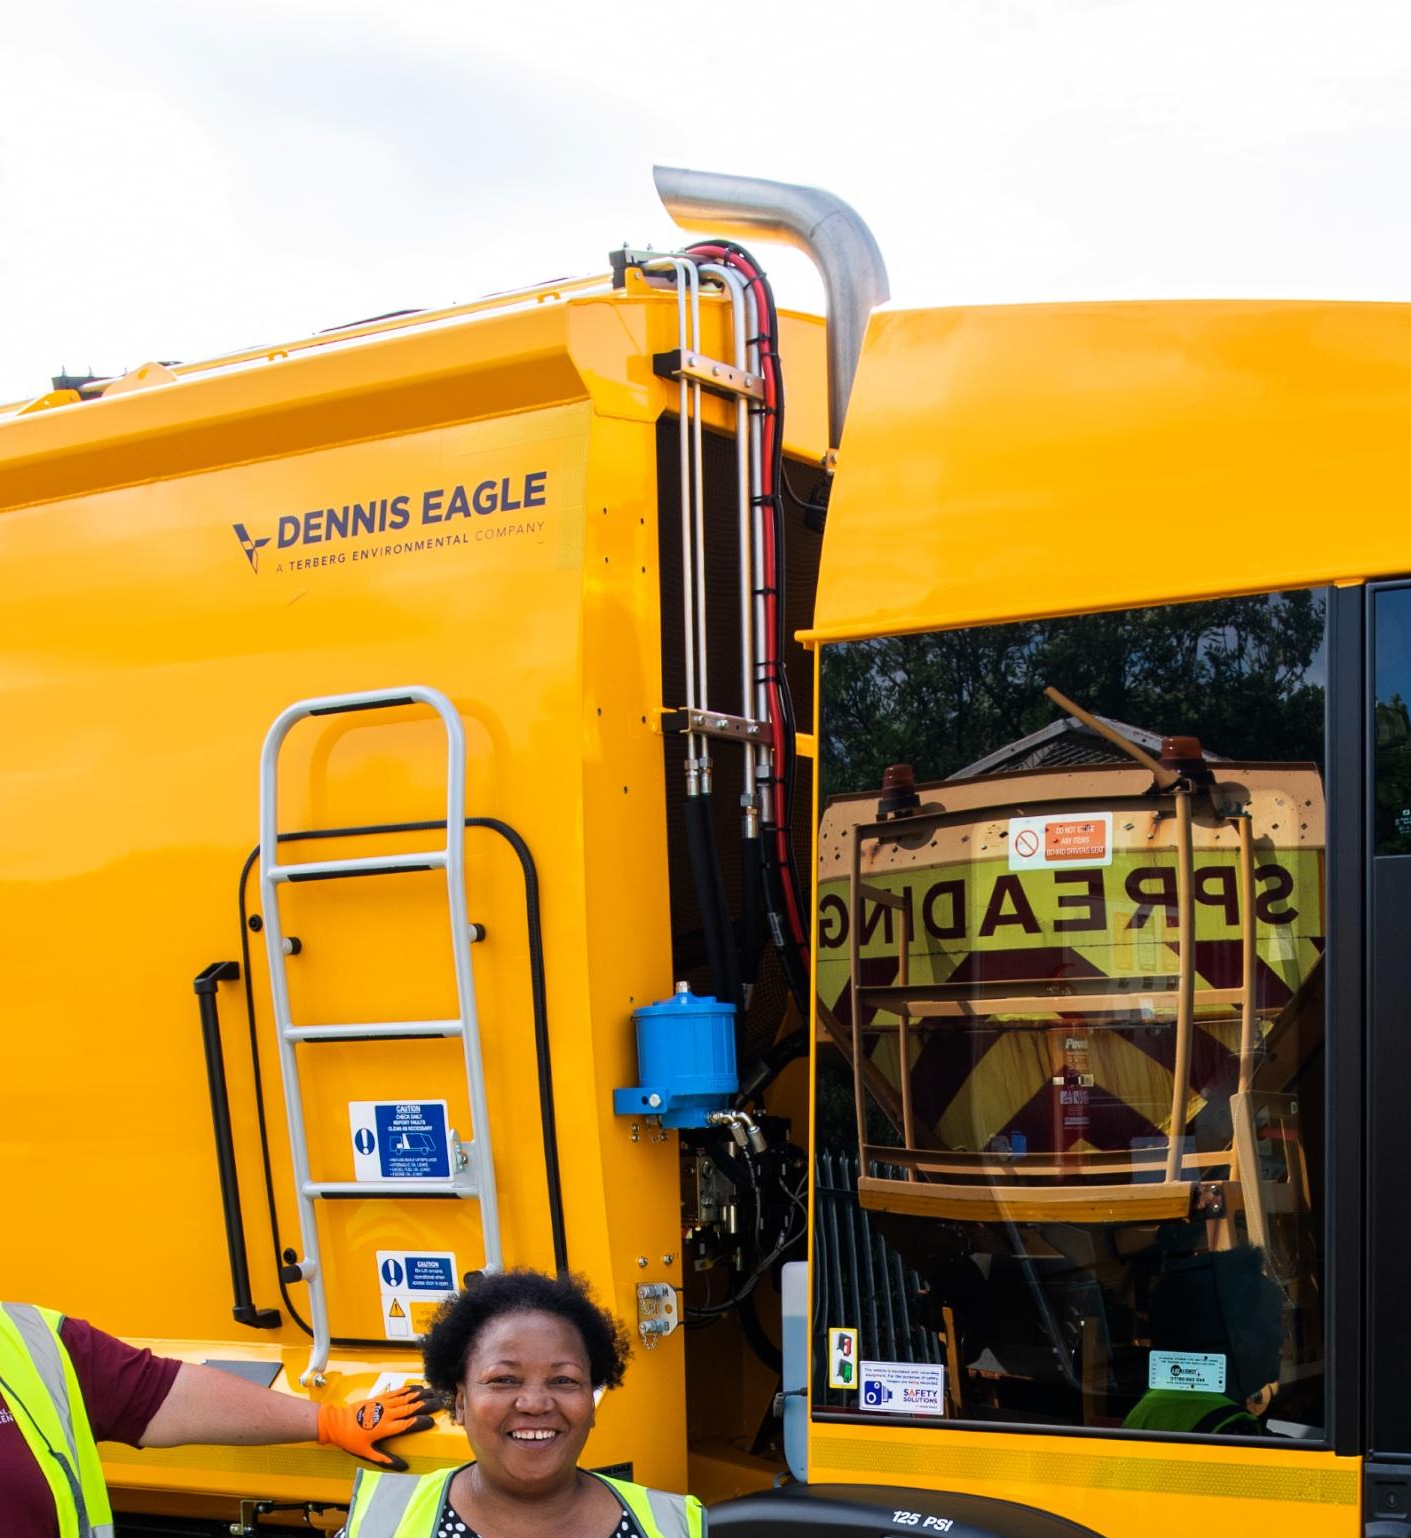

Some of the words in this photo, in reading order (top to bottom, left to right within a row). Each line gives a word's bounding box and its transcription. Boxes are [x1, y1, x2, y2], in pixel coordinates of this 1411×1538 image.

[278, 495, 409, 548] DENNIS
[422, 471, 546, 524] EAGLE
[275, 563, 284, 573] A
[289, 552, 346, 571] TERBERG
[352, 533, 469, 561] ENVIRONMENTAL
[475, 521, 545, 542] COMPANY
[396, 1105, 420, 1113] CAUTION
[662, 1287, 669, 1297] M
[664, 1321, 670, 1331] B
[904, 1389, 937, 1397] SAFETY
[892, 1510, 921, 1525] 125
[923, 1515, 953, 1531] PSI
